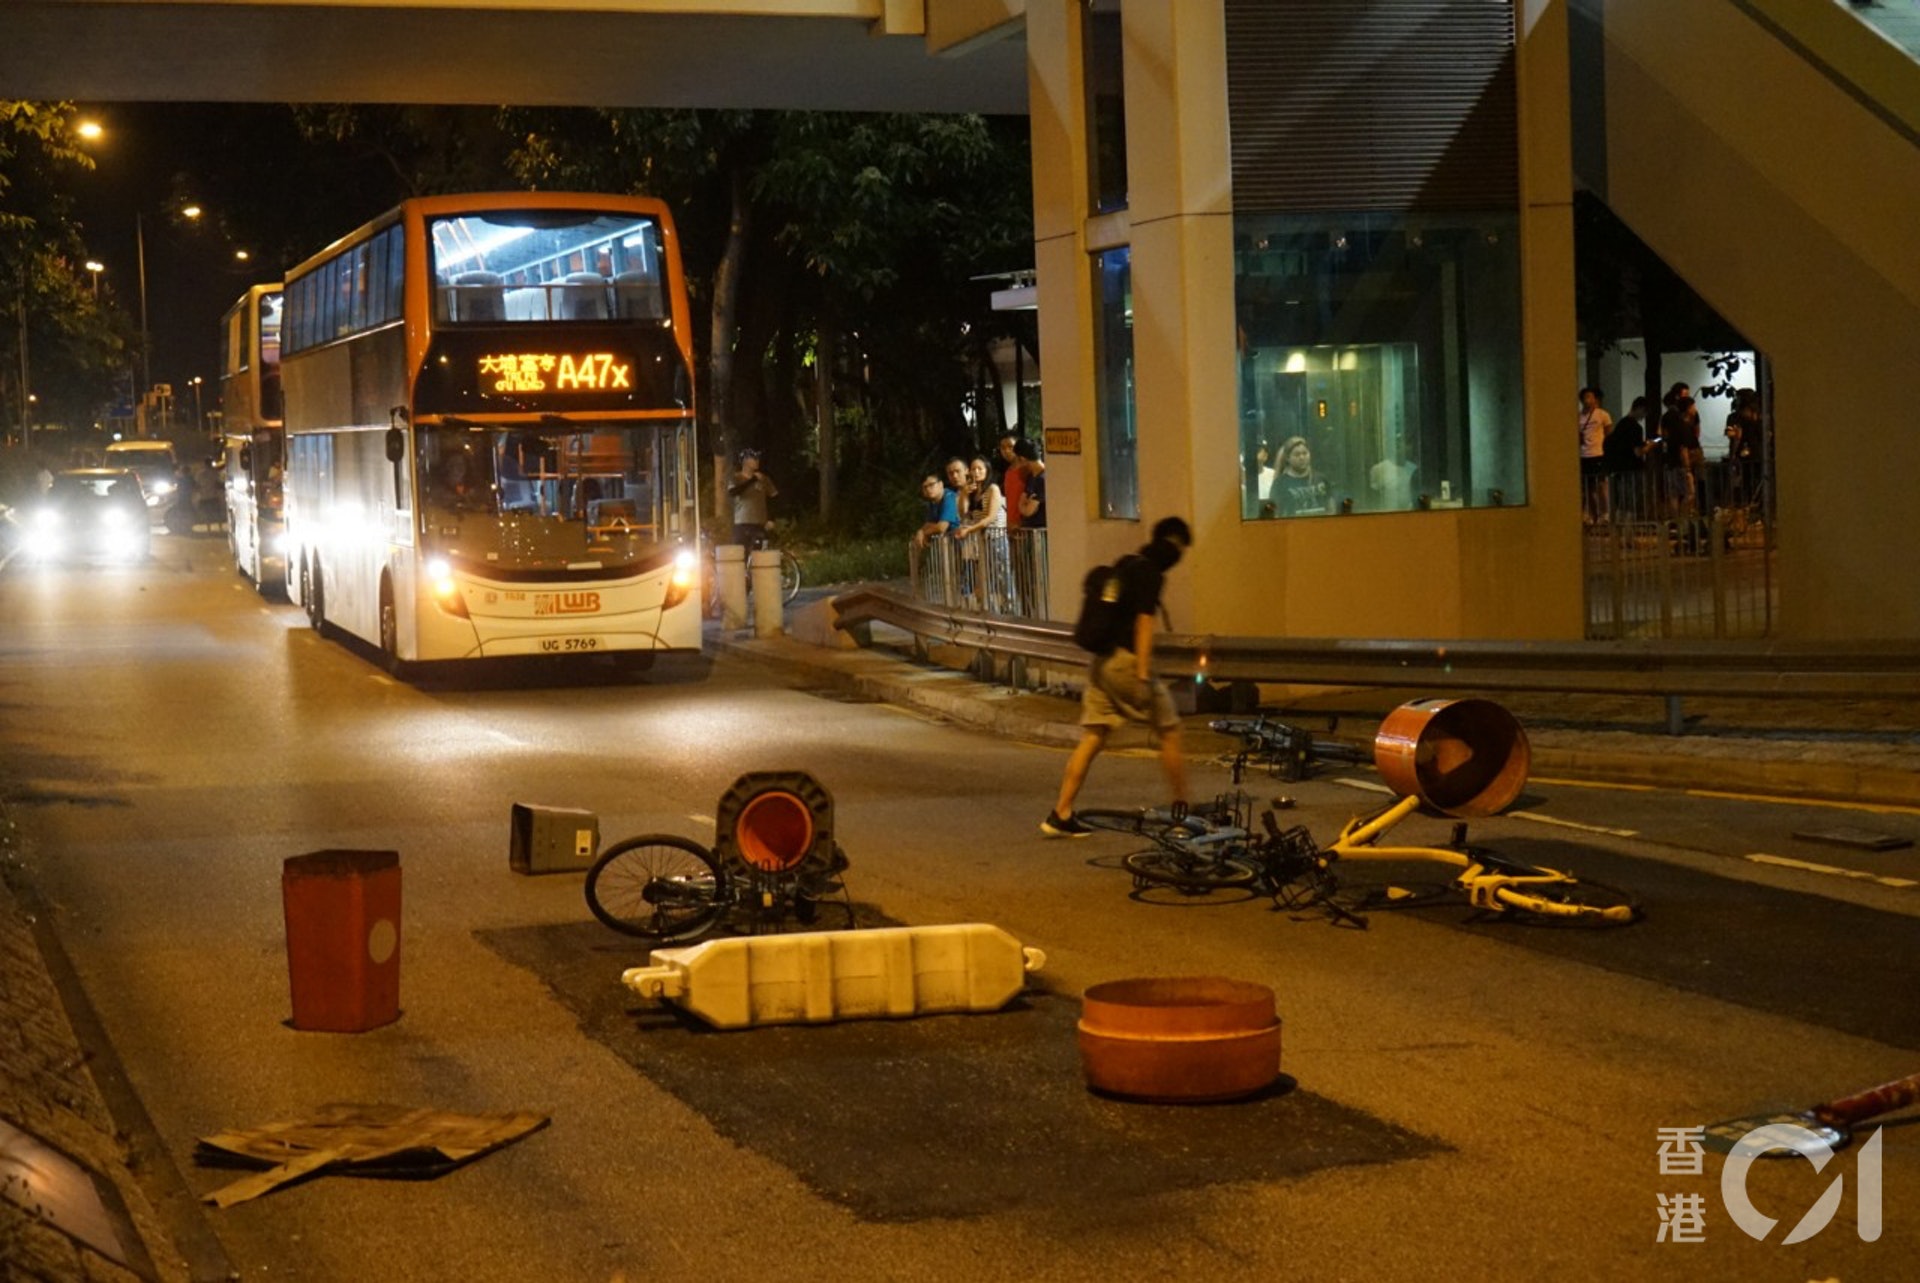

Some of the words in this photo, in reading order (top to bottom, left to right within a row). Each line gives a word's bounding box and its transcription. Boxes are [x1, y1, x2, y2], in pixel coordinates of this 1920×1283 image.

[557, 354, 629, 389] A47x
[554, 592, 601, 614] LWB
[542, 640, 560, 651] UG
[565, 638, 597, 649] 5769
